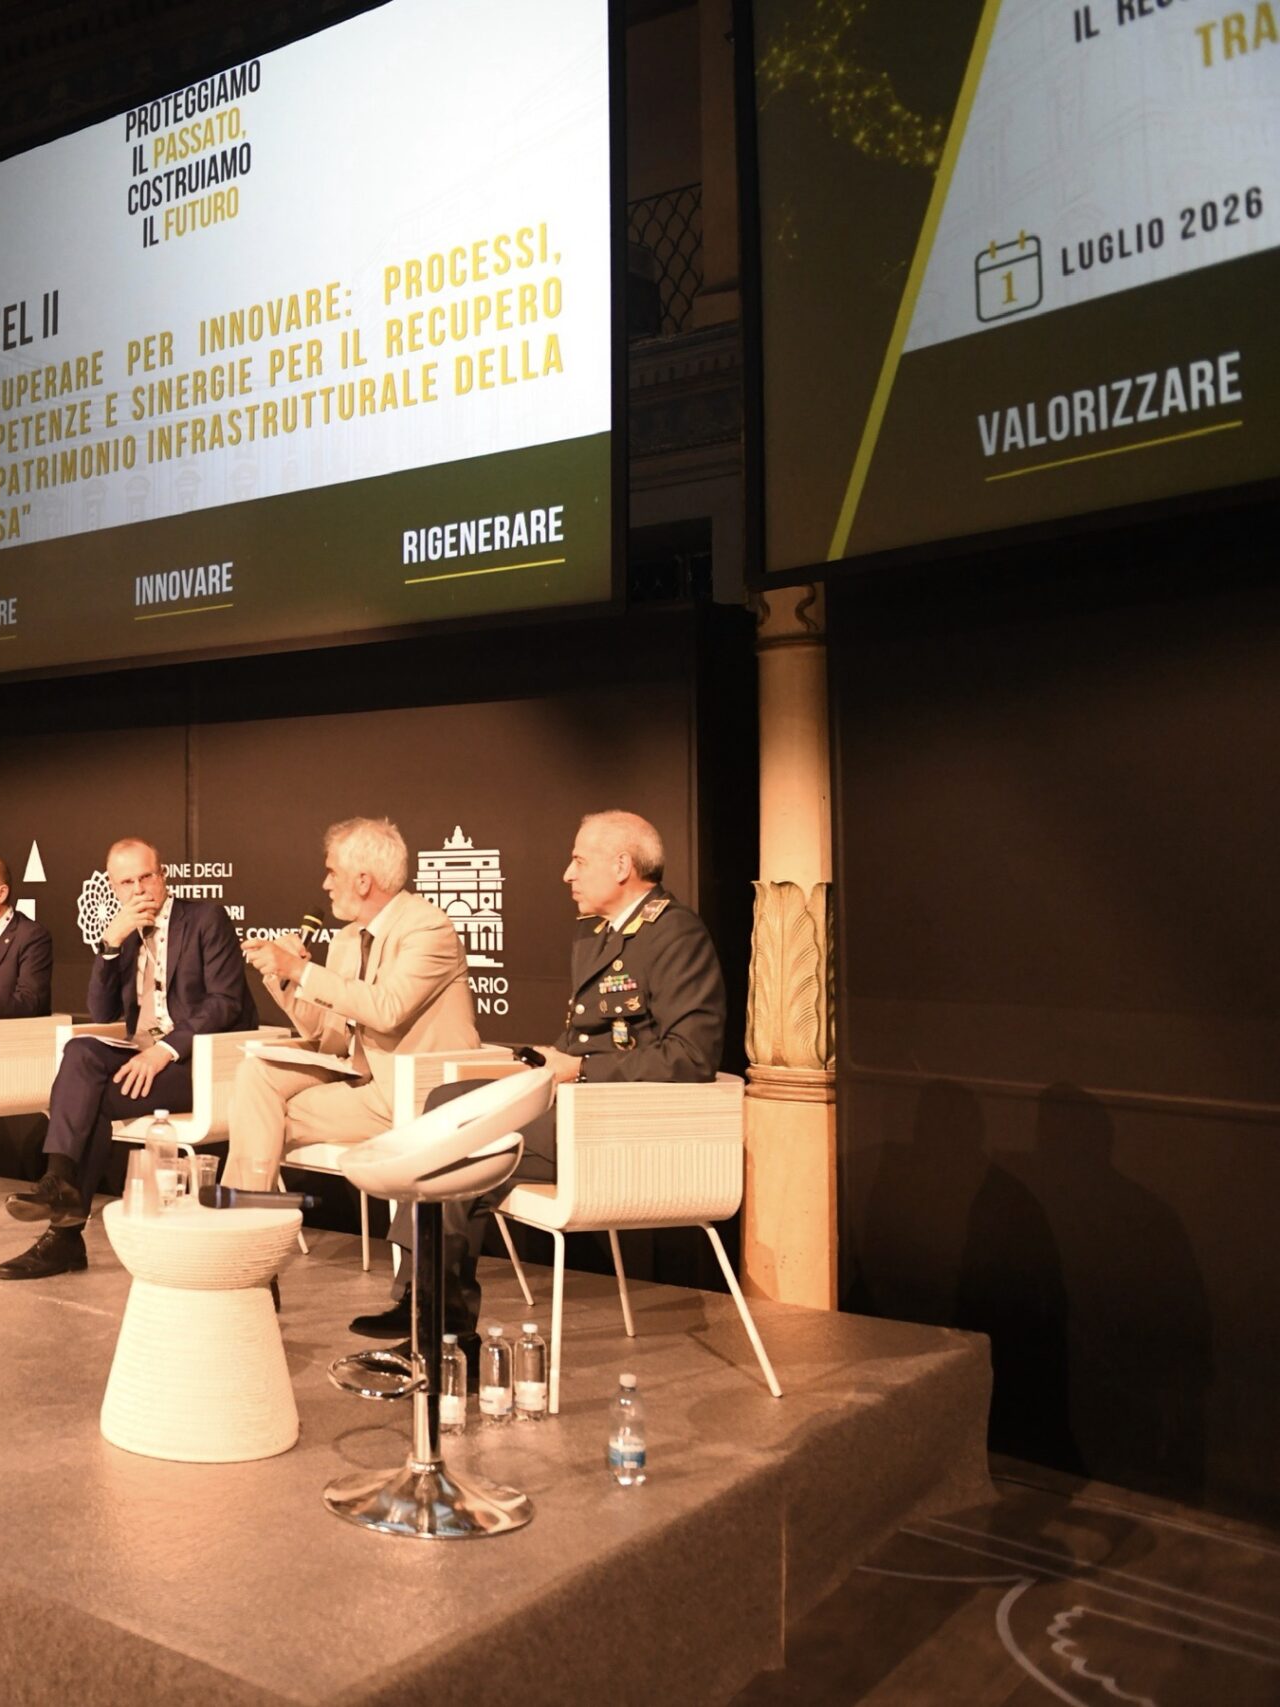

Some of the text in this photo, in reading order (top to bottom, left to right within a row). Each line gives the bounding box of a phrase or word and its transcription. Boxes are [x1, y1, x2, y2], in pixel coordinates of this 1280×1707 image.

[1074, 5, 1100, 43] IL
[1195, 1, 1278, 68] TRA
[125, 59, 261, 143] PROTEGGIAMO
[132, 106, 246, 177] IL PASSATO,
[127, 142, 251, 215] COSTRUIAMO
[143, 186, 239, 249] IL FUTURO
[1001, 186, 1264, 305] 1 LUGLIO 2026
[42, 289, 59, 339] II
[127, 330, 174, 376] PER
[199, 281, 351, 356] INNOVARE:
[384, 222, 562, 305] PROCESSI,
[106, 392, 118, 428] E
[131, 357, 252, 421] SINERGIE
[270, 338, 323, 388] PER
[341, 328, 367, 370] IL
[386, 276, 563, 358] RECUPERO
[147, 361, 438, 464] INFRASTRUTTURALE
[454, 333, 564, 396] DELLA
[978, 351, 1243, 457] VALORIZZARE
[402, 505, 565, 565] RIGENERARE
[134, 561, 234, 605] INNOVARE
[166, 884, 223, 899] HITETTI
[194, 862, 233, 878] DEGLI
[477, 998, 509, 1015] NO
